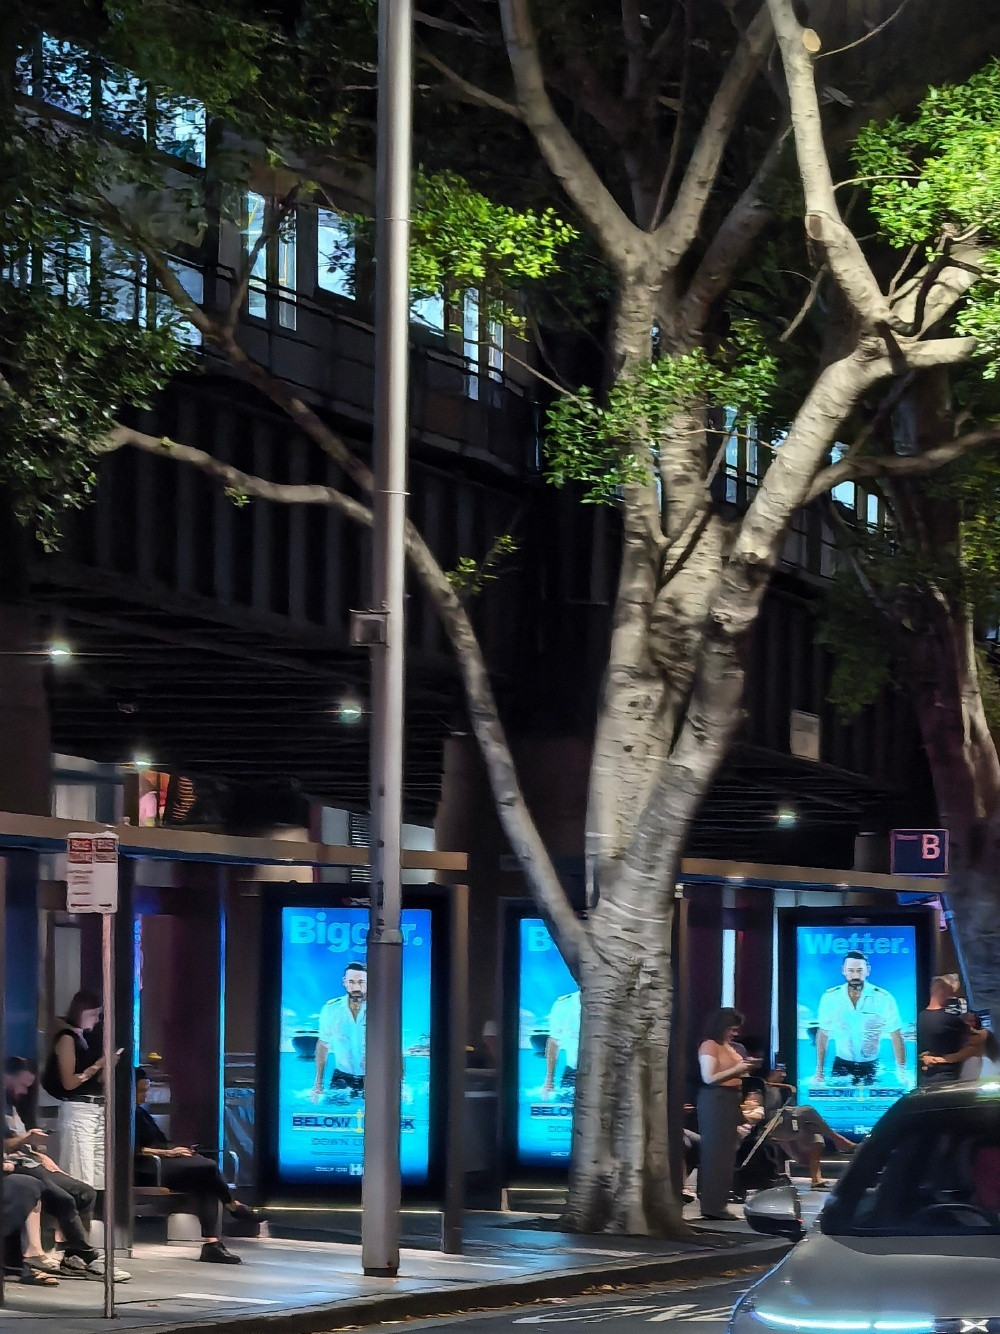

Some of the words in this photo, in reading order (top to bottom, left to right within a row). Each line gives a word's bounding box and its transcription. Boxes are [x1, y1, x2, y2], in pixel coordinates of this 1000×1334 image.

[922, 834, 940, 859] B
[290, 912, 423, 953] Biggr.
[804, 933, 909, 954] Wetter.
[531, 1106, 573, 1116] BELO
[292, 1116, 350, 1128] BELOW
